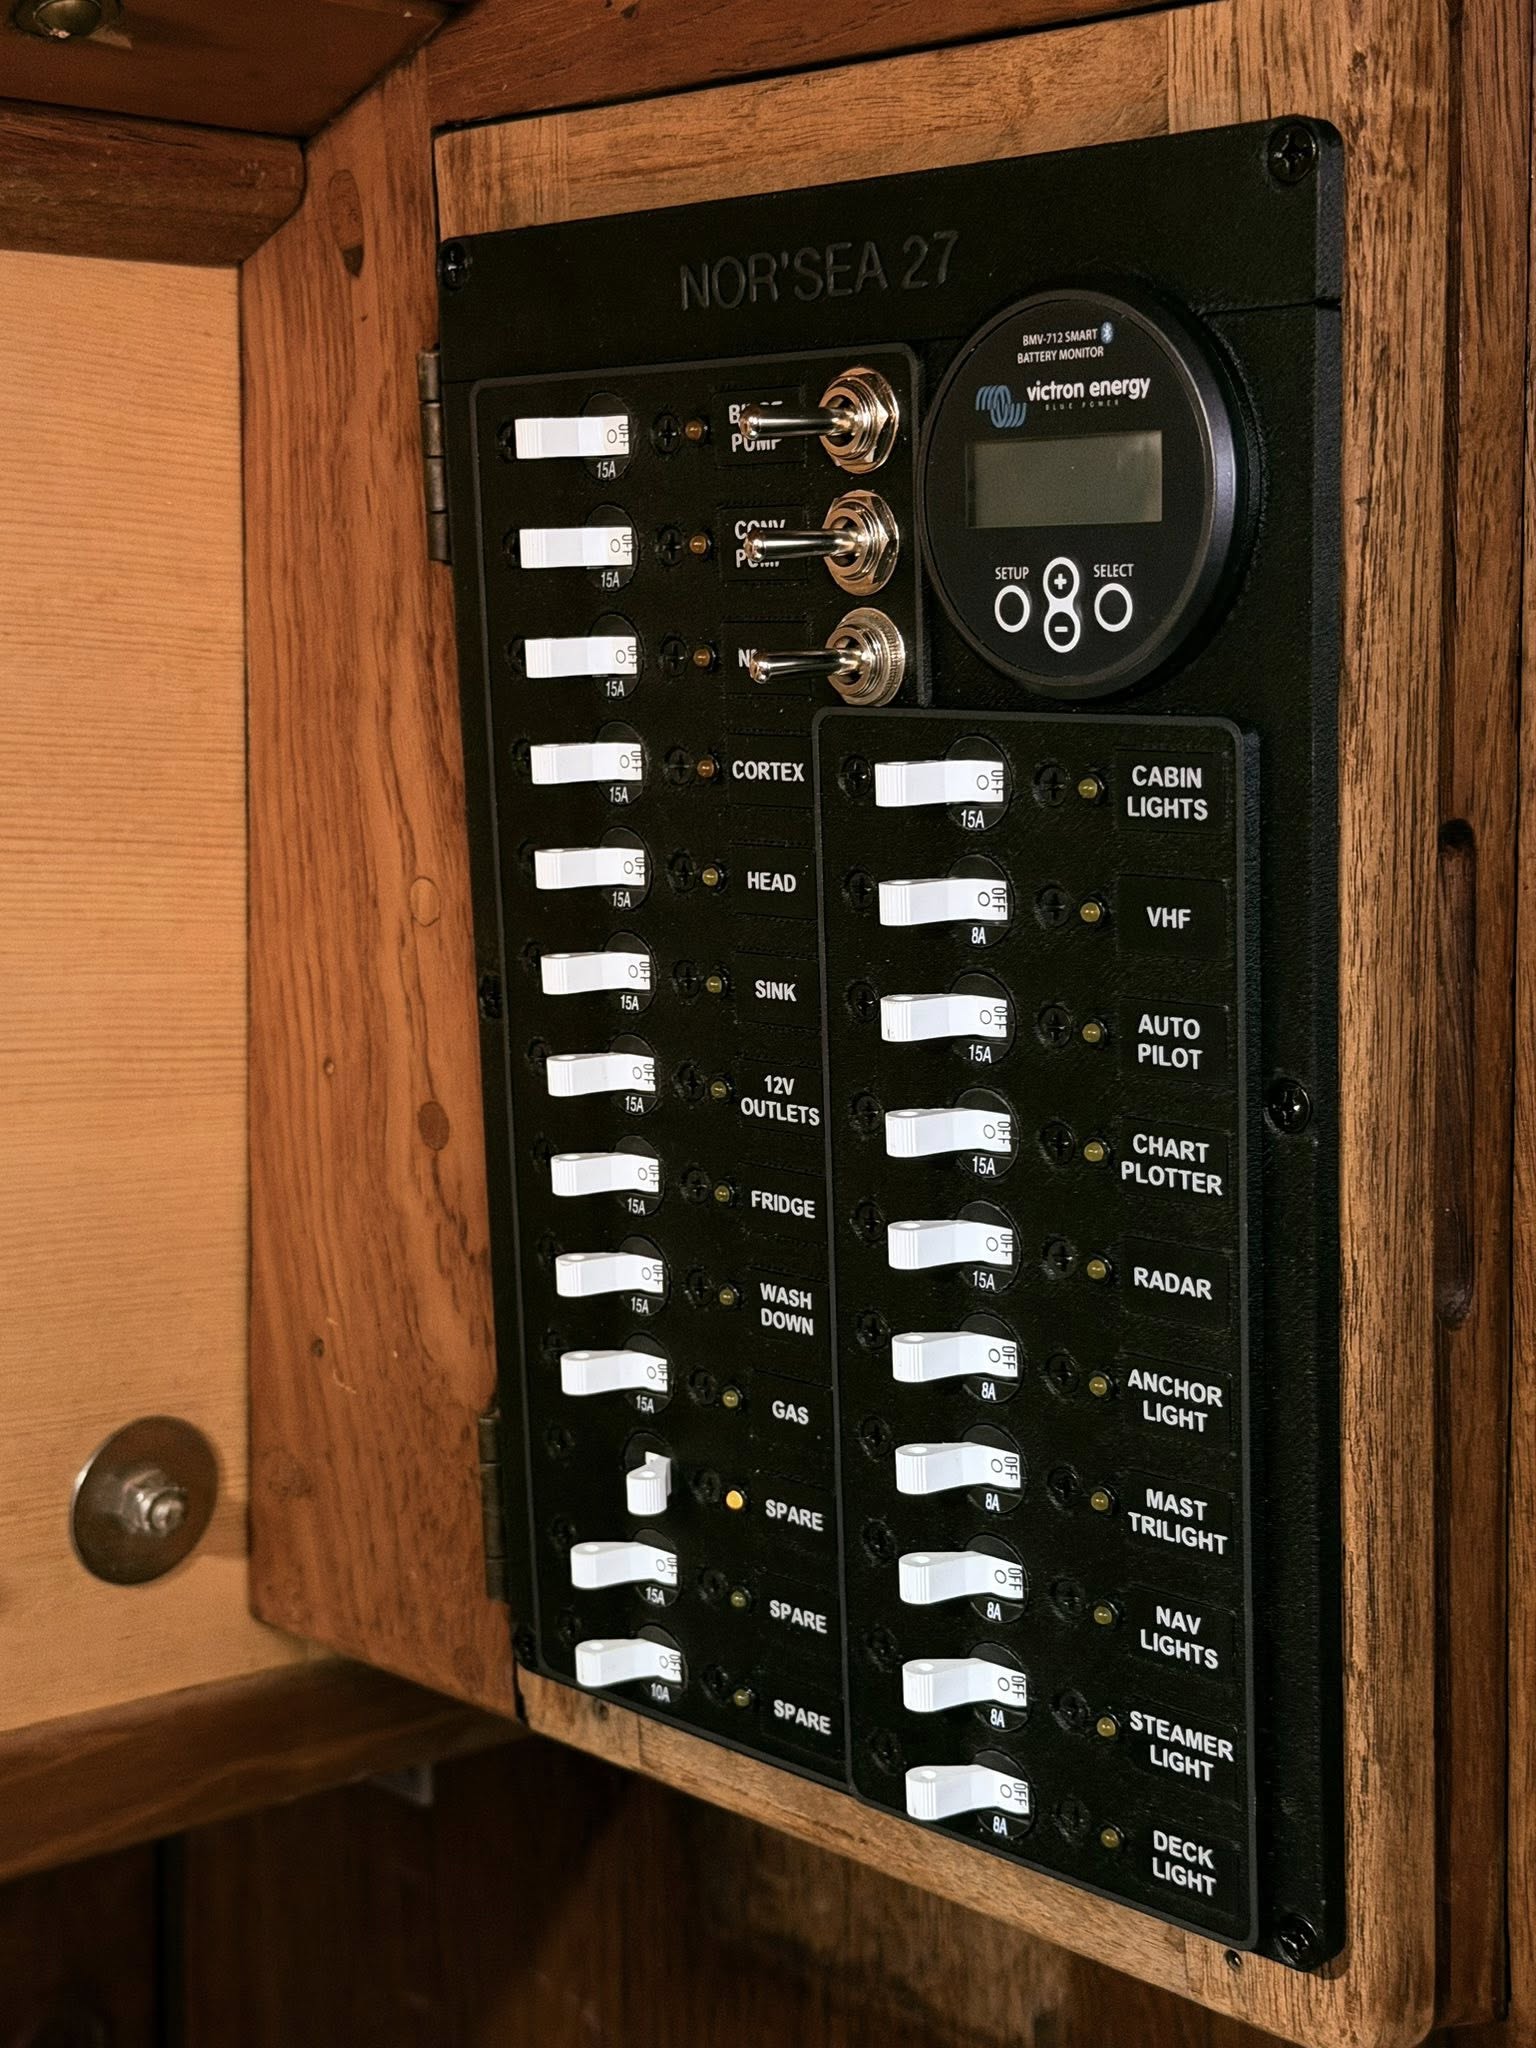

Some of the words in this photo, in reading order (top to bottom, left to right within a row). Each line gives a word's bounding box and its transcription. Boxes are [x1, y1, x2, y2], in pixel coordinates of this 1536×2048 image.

[680, 240, 889, 311] NOR'SEA
[901, 230, 959, 291] 27
[1022, 333, 1063, 346] BMV-712
[1064, 328, 1098, 343] SMART
[1017, 350, 1057, 364] BATTERY
[1058, 346, 1104, 361] MONITOR
[1027, 380, 1084, 401] victron
[1089, 377, 1151, 400] energy
[1045, 402, 1073, 411] BLUE
[596, 460, 617, 479] 15A
[600, 570, 620, 588] 15A
[994, 566, 1030, 581] SETUP
[1093, 563, 1135, 578] SELECT
[605, 679, 625, 697] 15A
[731, 760, 805, 782] CORTEX
[1131, 764, 1203, 789] CABIN
[609, 786, 629, 804] 15A
[960, 809, 985, 829] 15A
[1127, 795, 1209, 822] LIGHTS
[747, 870, 797, 893] HEAD
[612, 891, 632, 908] 15A
[1146, 906, 1192, 930] VHF
[971, 926, 987, 945] 8A
[754, 979, 797, 1002] SINK
[620, 994, 640, 1011] 15A
[1137, 1013, 1201, 1040] AUTO
[968, 1043, 993, 1064] 15A
[1137, 1043, 1203, 1070] PILOT
[764, 1074, 795, 1096] 12V
[625, 1095, 645, 1113] 15A
[740, 1097, 820, 1126] OUTLETS
[1132, 1133, 1210, 1164] CHART
[972, 1155, 997, 1176] 15A
[1120, 1160, 1223, 1197] PLOTTER
[627, 1197, 646, 1216] 15A
[751, 1190, 816, 1219] FRIDGE
[972, 1270, 996, 1291] 15A
[1133, 1266, 1213, 1301] RADAR
[630, 1296, 650, 1315] 15A
[759, 1282, 812, 1311] WASH
[760, 1307, 814, 1336] DOWN
[981, 1381, 997, 1401] 8A
[1127, 1368, 1224, 1408] ANCHOR
[635, 1394, 655, 1414] 15A
[771, 1400, 810, 1425] GAS
[1142, 1399, 1209, 1433] LIGHT
[985, 1492, 1001, 1512] 8A
[1146, 1488, 1208, 1521] MAST
[765, 1498, 824, 1532] SPARE
[1127, 1511, 1229, 1555] TRILIGHT
[645, 1586, 666, 1606] 15A
[769, 1599, 828, 1634] SPARE
[986, 1602, 1001, 1621] 8A
[1156, 1605, 1202, 1636] NAV
[1140, 1628, 1219, 1670] LIGHTS
[650, 1682, 671, 1703] 10A
[773, 1699, 832, 1735] SPARE
[989, 1707, 1006, 1729] 8A
[1129, 1710, 1235, 1763] STEAMER
[1149, 1744, 1215, 1782] LIGHT
[992, 1815, 1008, 1837] 8A
[1153, 1829, 1215, 1870] DECK
[1152, 1856, 1217, 1897] LIGHT
